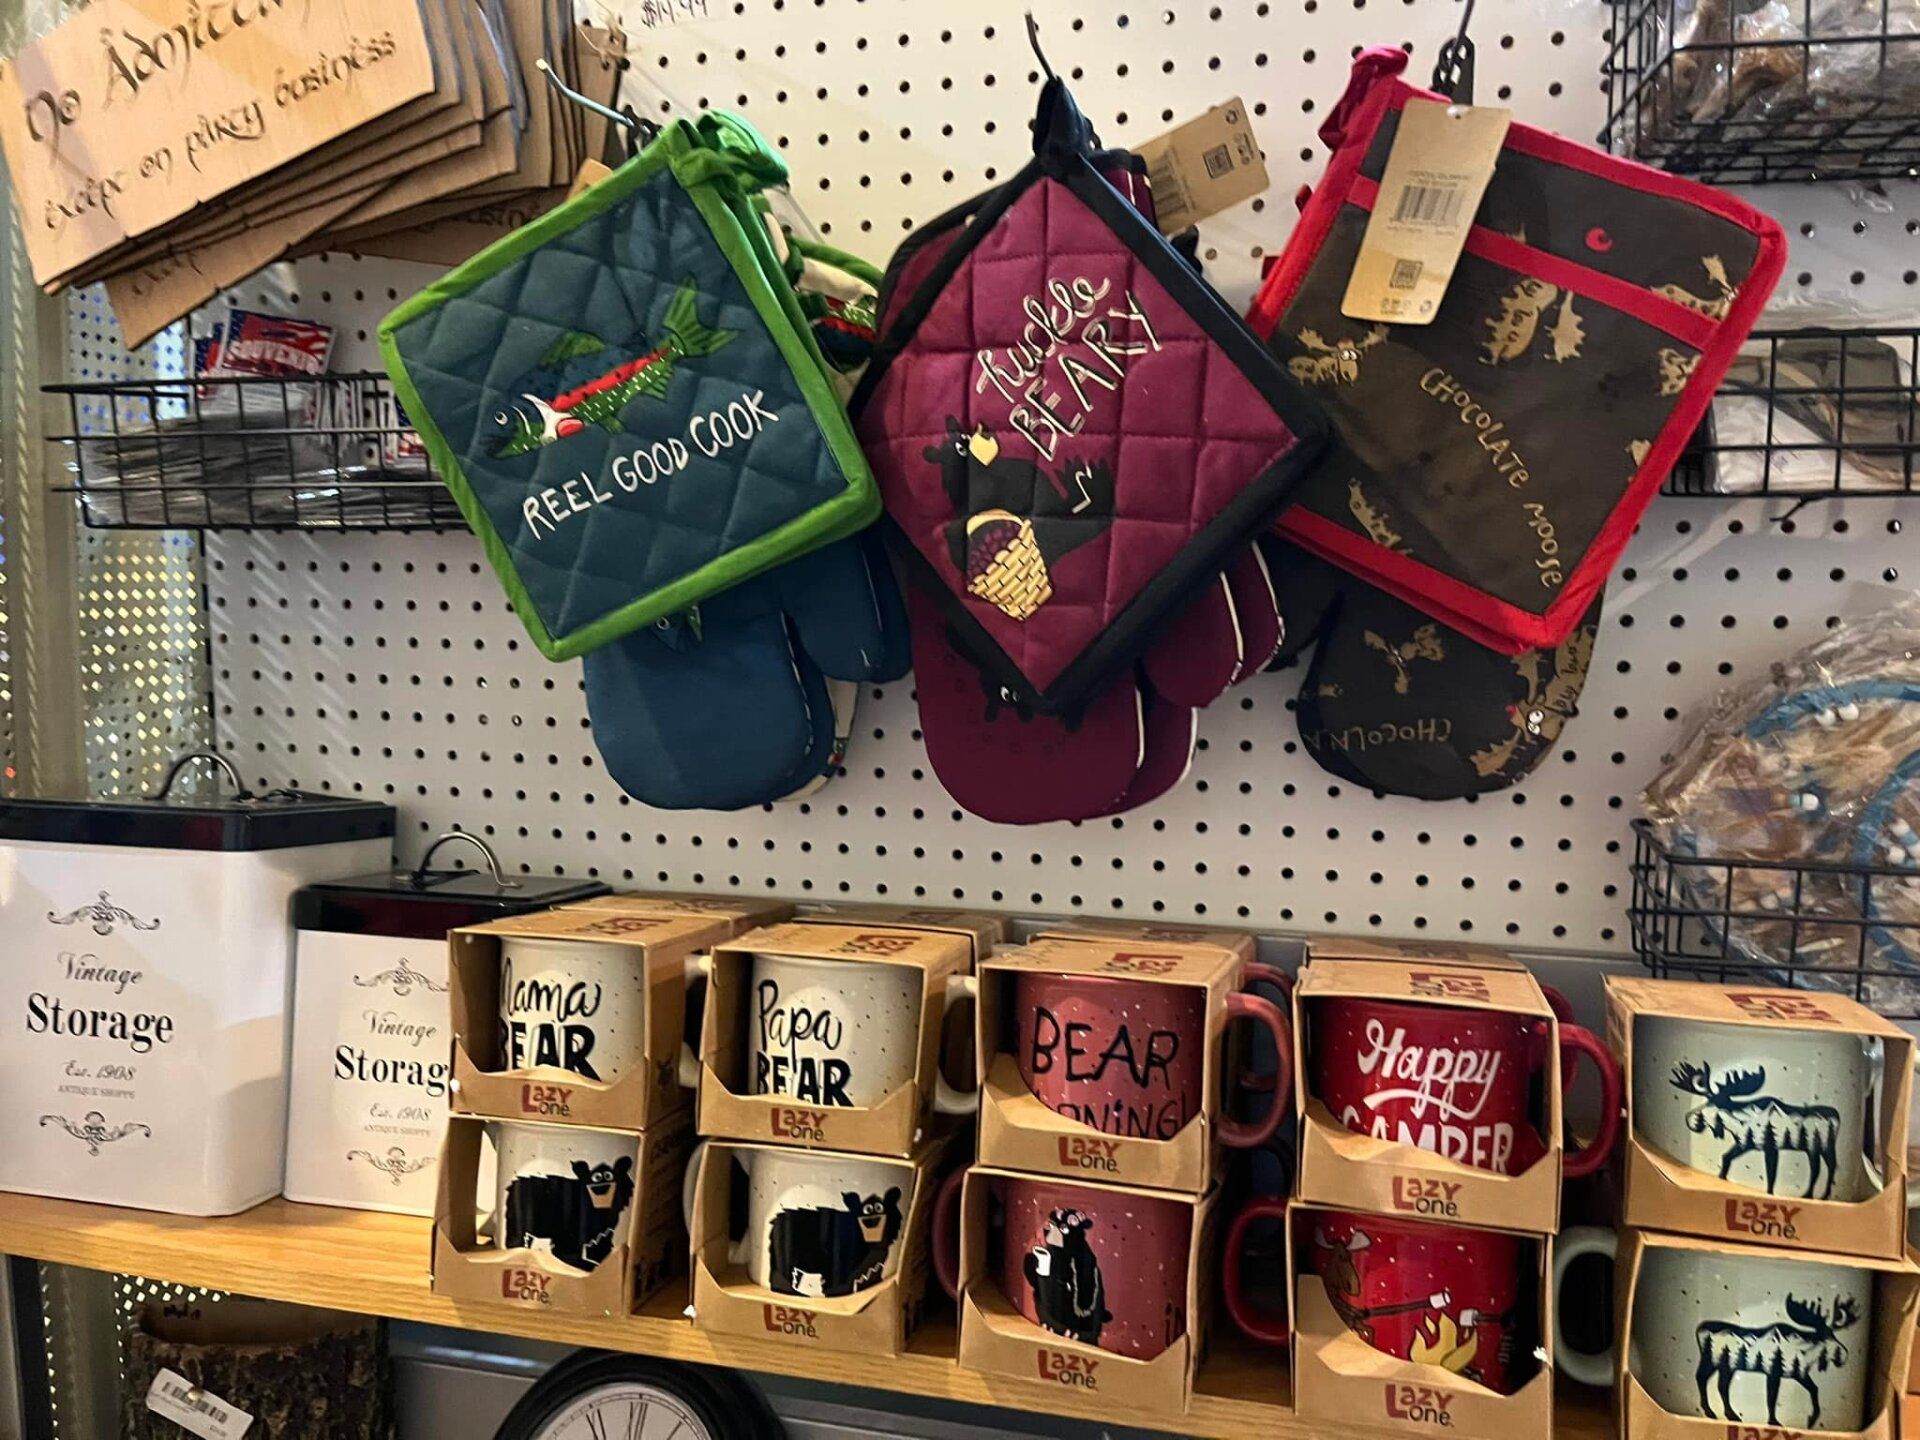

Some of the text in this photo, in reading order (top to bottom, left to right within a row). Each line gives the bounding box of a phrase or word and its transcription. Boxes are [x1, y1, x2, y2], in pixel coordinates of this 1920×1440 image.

[140, 147, 172, 184] on
[1009, 291, 1163, 462] BEARY
[523, 390, 780, 540] REEL GOOD COOK
[57, 951, 144, 994] Vintage
[27, 992, 174, 1053] Storage
[363, 1009, 437, 1046] Vintage
[758, 979, 842, 1075] Papa
[1031, 1007, 1180, 1090] BEAR
[334, 1045, 448, 1097] Storag
[756, 1051, 855, 1107] BEAR
[1357, 1018, 1501, 1122] Happy
